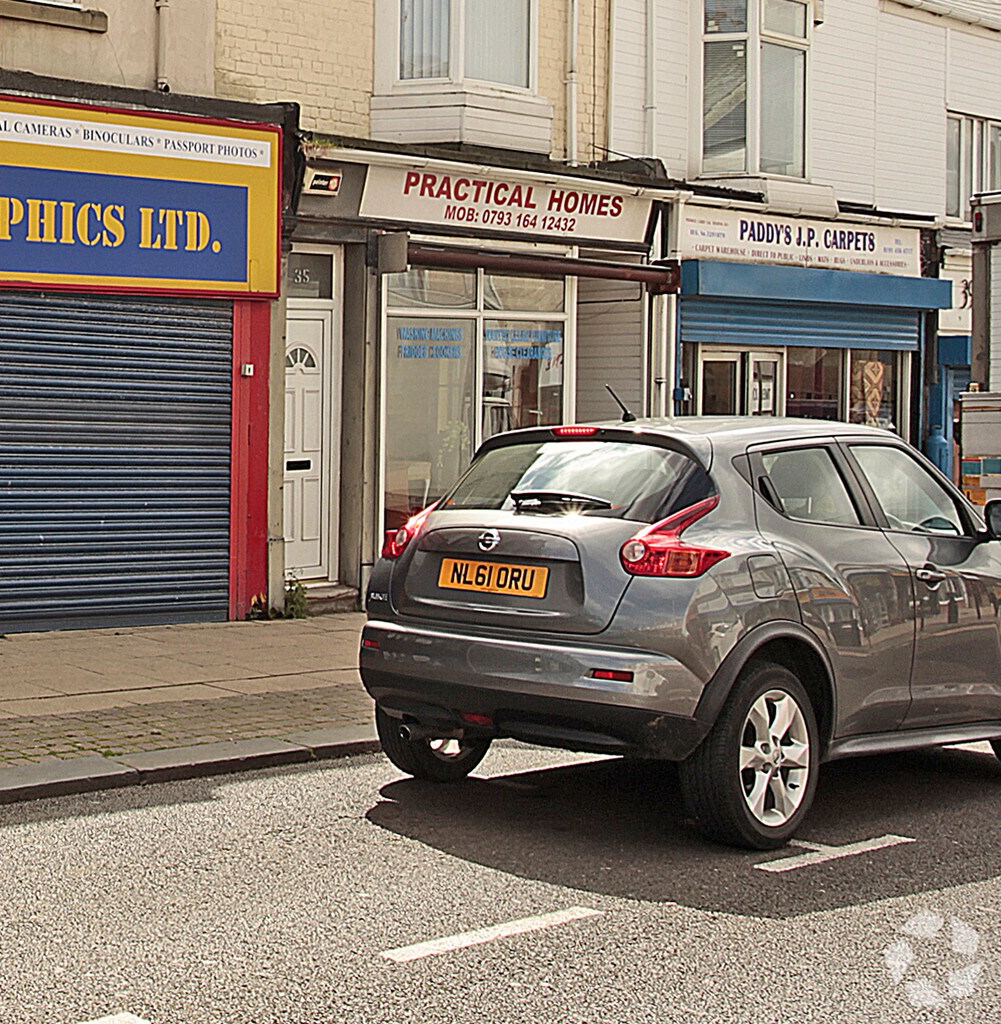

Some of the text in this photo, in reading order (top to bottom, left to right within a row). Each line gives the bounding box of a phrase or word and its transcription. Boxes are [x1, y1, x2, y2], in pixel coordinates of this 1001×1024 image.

[14, 121, 72, 138] CAMERAS
[83, 128, 155, 148] BINOCULARS
[164, 138, 216, 155] PASSPORT
[217, 145, 258, 159] PHOTOS
[403, 171, 624, 218] PRACTICAL HOMES
[138, 207, 222, 254] LTD.
[444, 205, 576, 232] MOB: 0793 164 12432
[740, 219, 875, 252] PADDY'S J.P. CARPETS
[294, 268, 310, 284] 35
[450, 562, 536, 591] NL61 ORU
